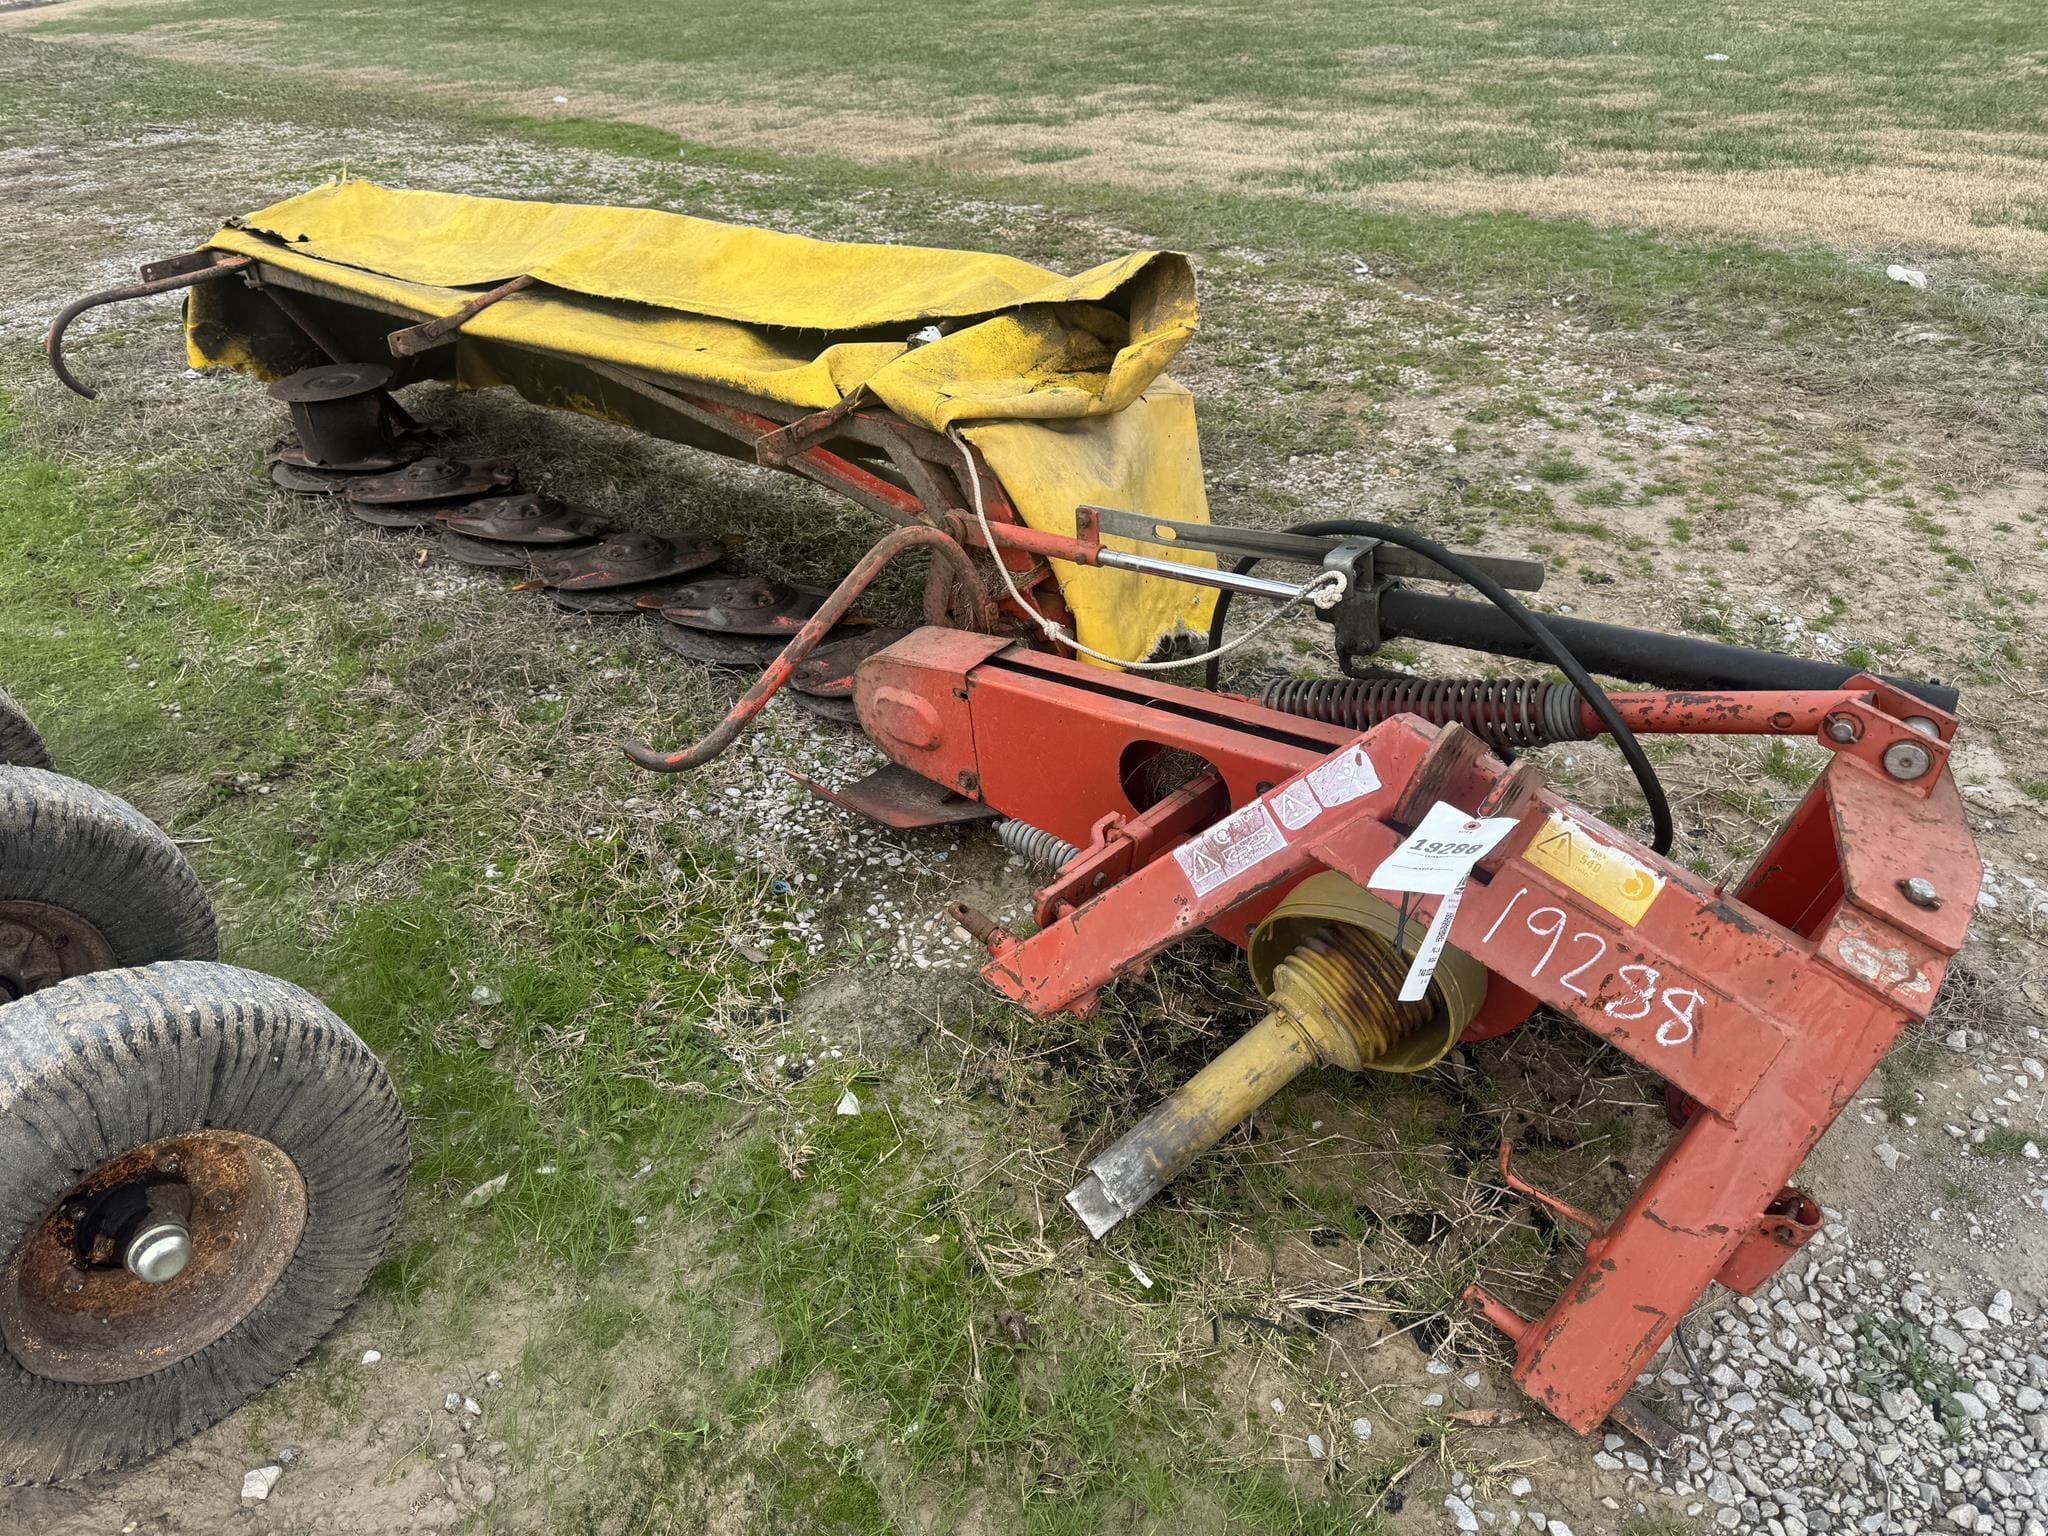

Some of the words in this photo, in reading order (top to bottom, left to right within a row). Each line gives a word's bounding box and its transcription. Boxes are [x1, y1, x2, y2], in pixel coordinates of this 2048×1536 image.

[1409, 838, 1484, 855] 19288
[1578, 854, 1602, 873] 540
[1484, 888, 1706, 1047] 19288
